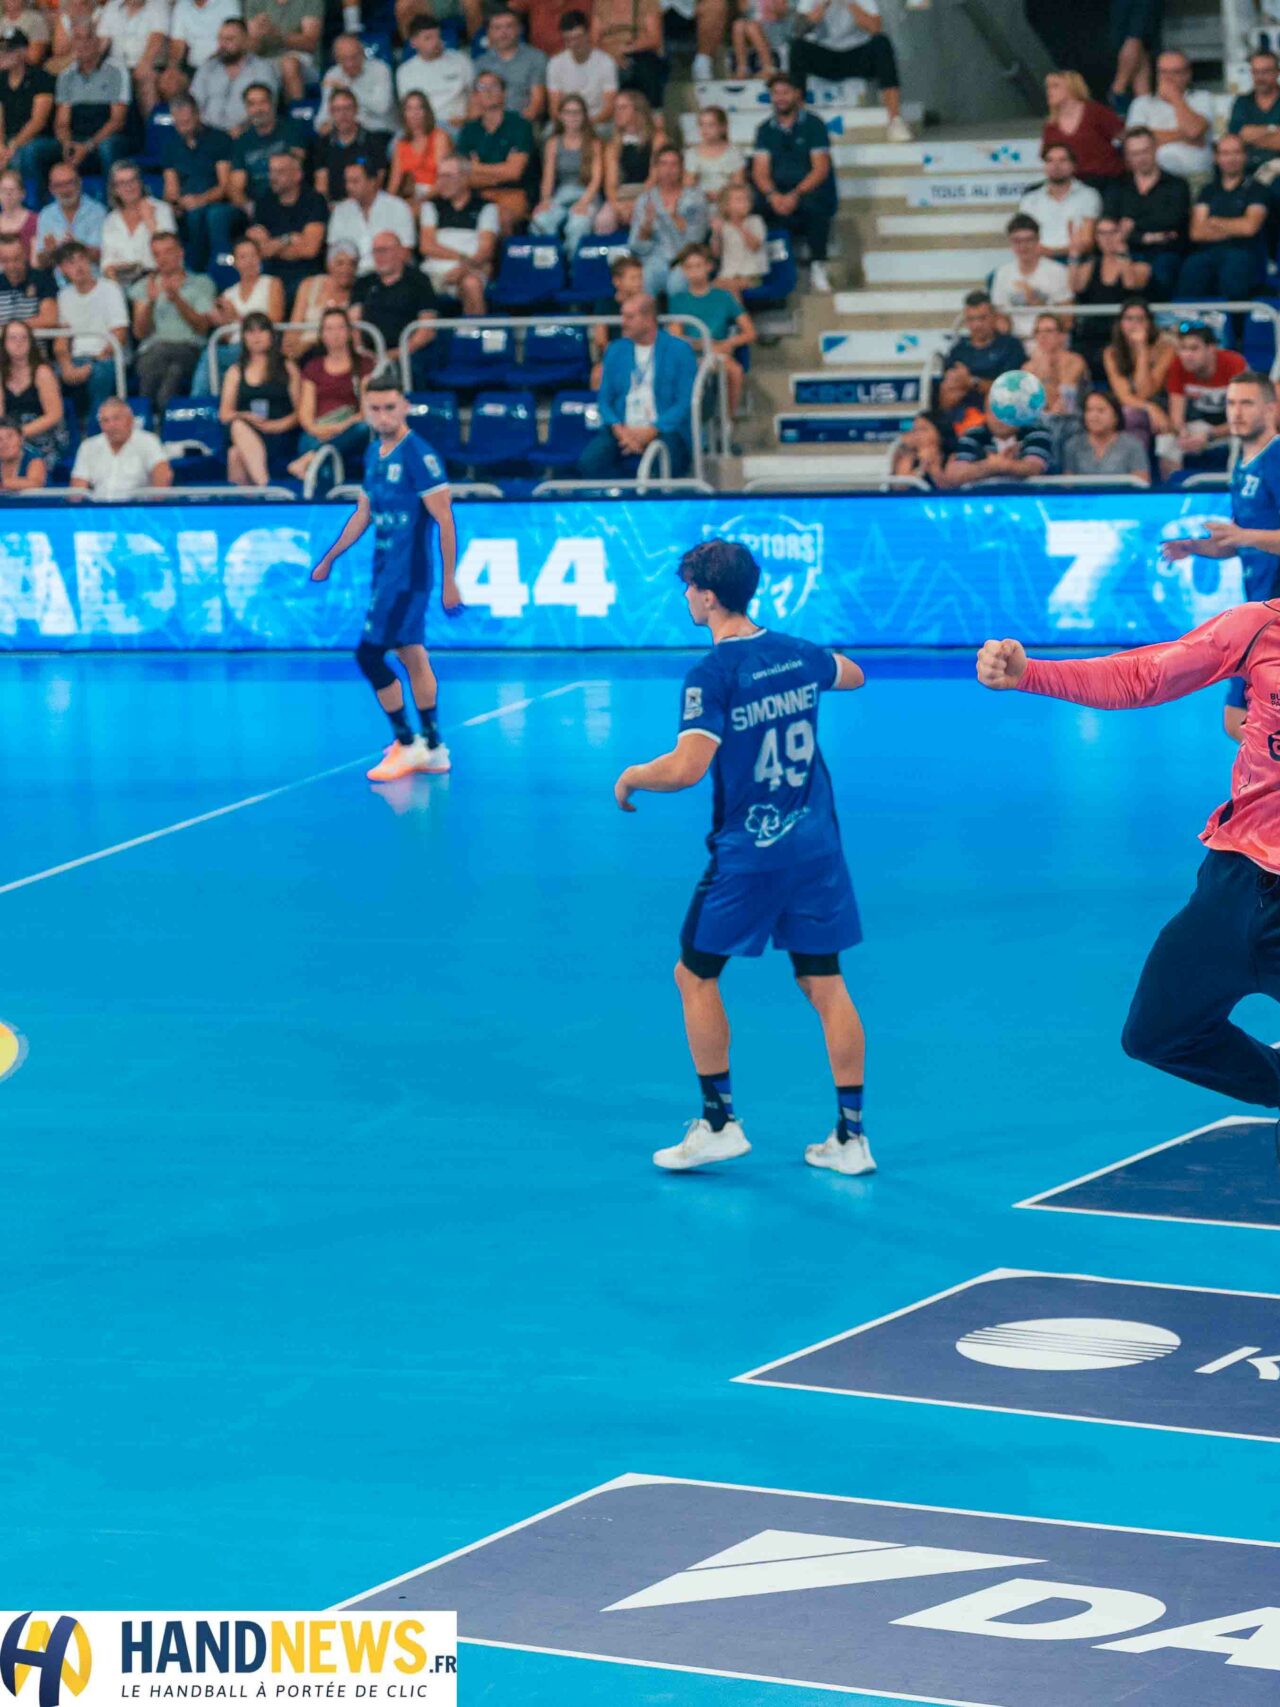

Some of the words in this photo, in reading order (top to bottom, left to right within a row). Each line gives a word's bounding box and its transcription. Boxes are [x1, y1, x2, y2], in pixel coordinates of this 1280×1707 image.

[456, 538, 616, 617] 44
[731, 682, 819, 731] SIMONNET
[754, 719, 815, 792] 49
